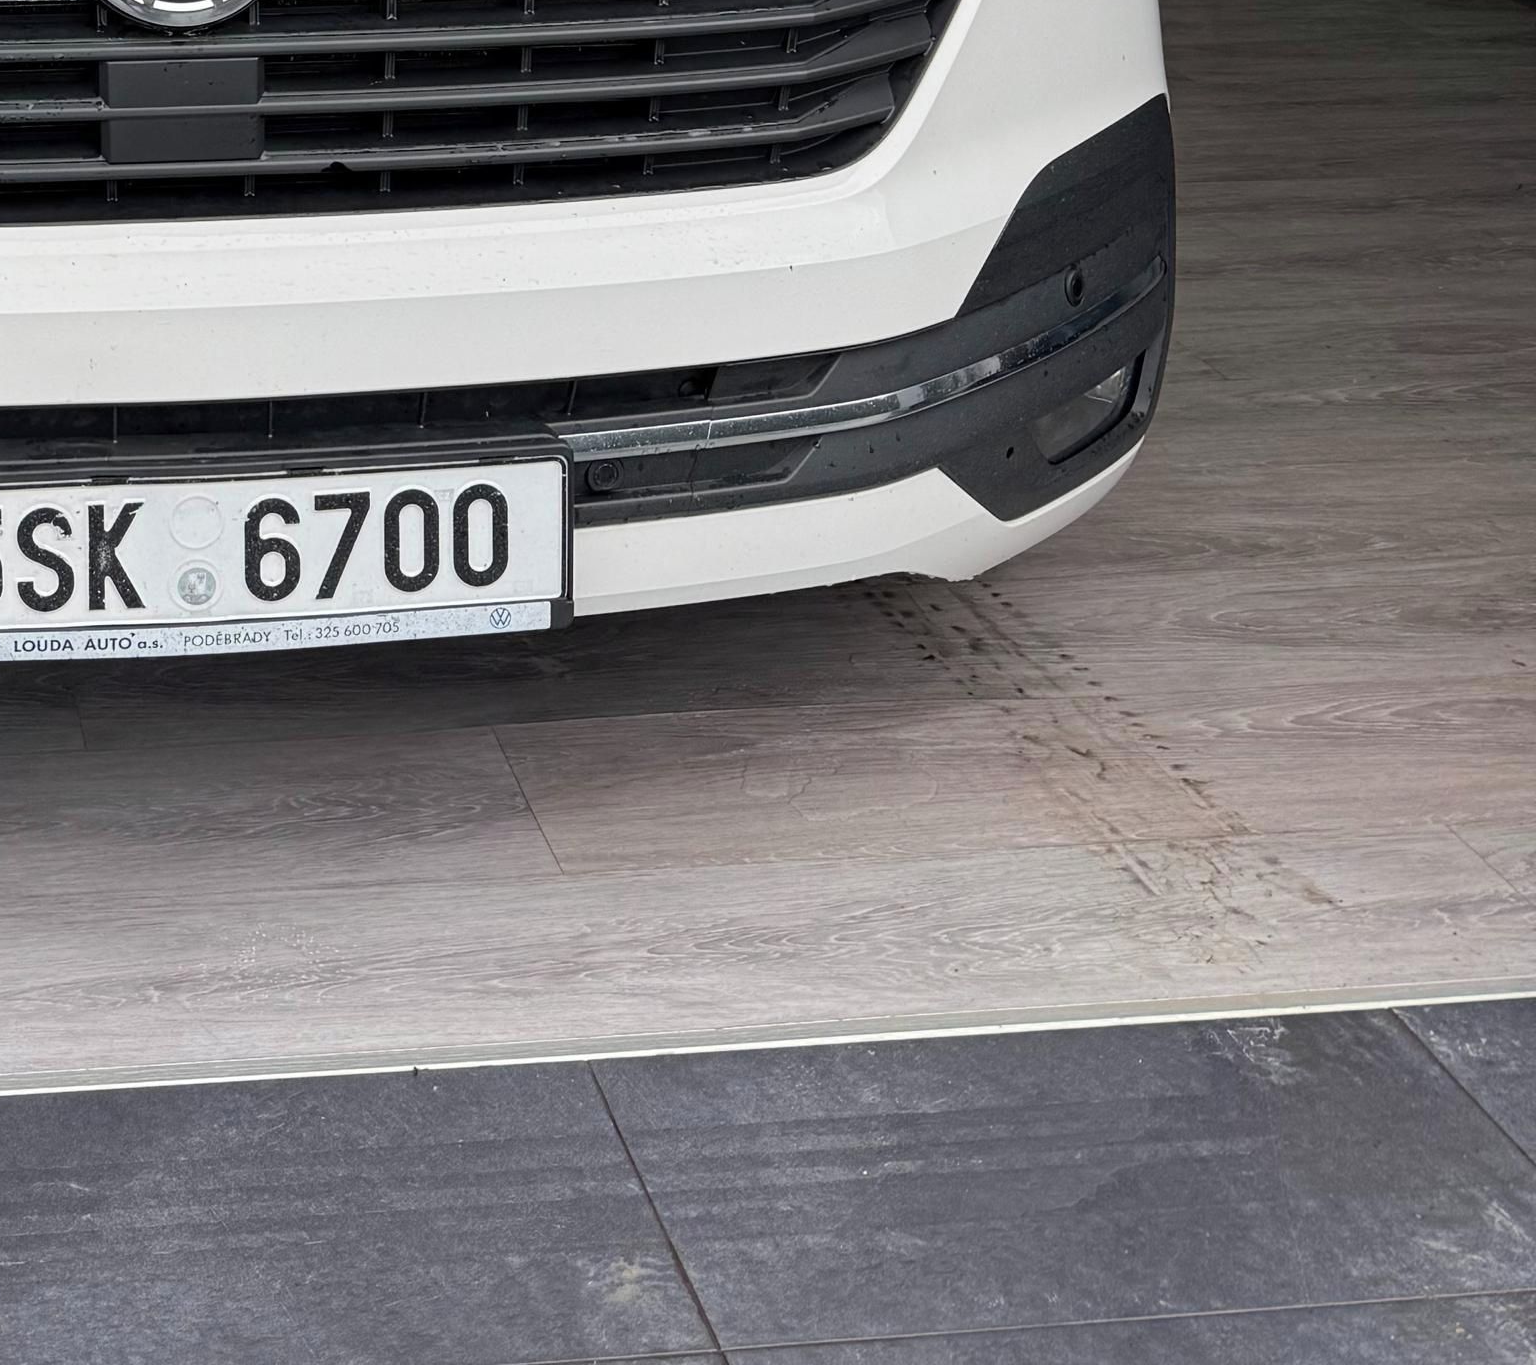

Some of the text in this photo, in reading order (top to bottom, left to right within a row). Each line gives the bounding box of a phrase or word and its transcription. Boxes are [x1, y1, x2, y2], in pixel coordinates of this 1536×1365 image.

[243, 482, 509, 603] 6700
[489, 606, 512, 629] VW
[13, 639, 74, 652] LOUDA
[83, 637, 132, 651] AUTO
[138, 639, 164, 649] a.s.
[315, 626, 340, 639] 325
[344, 623, 371, 636] 600
[375, 621, 399, 635] 705
